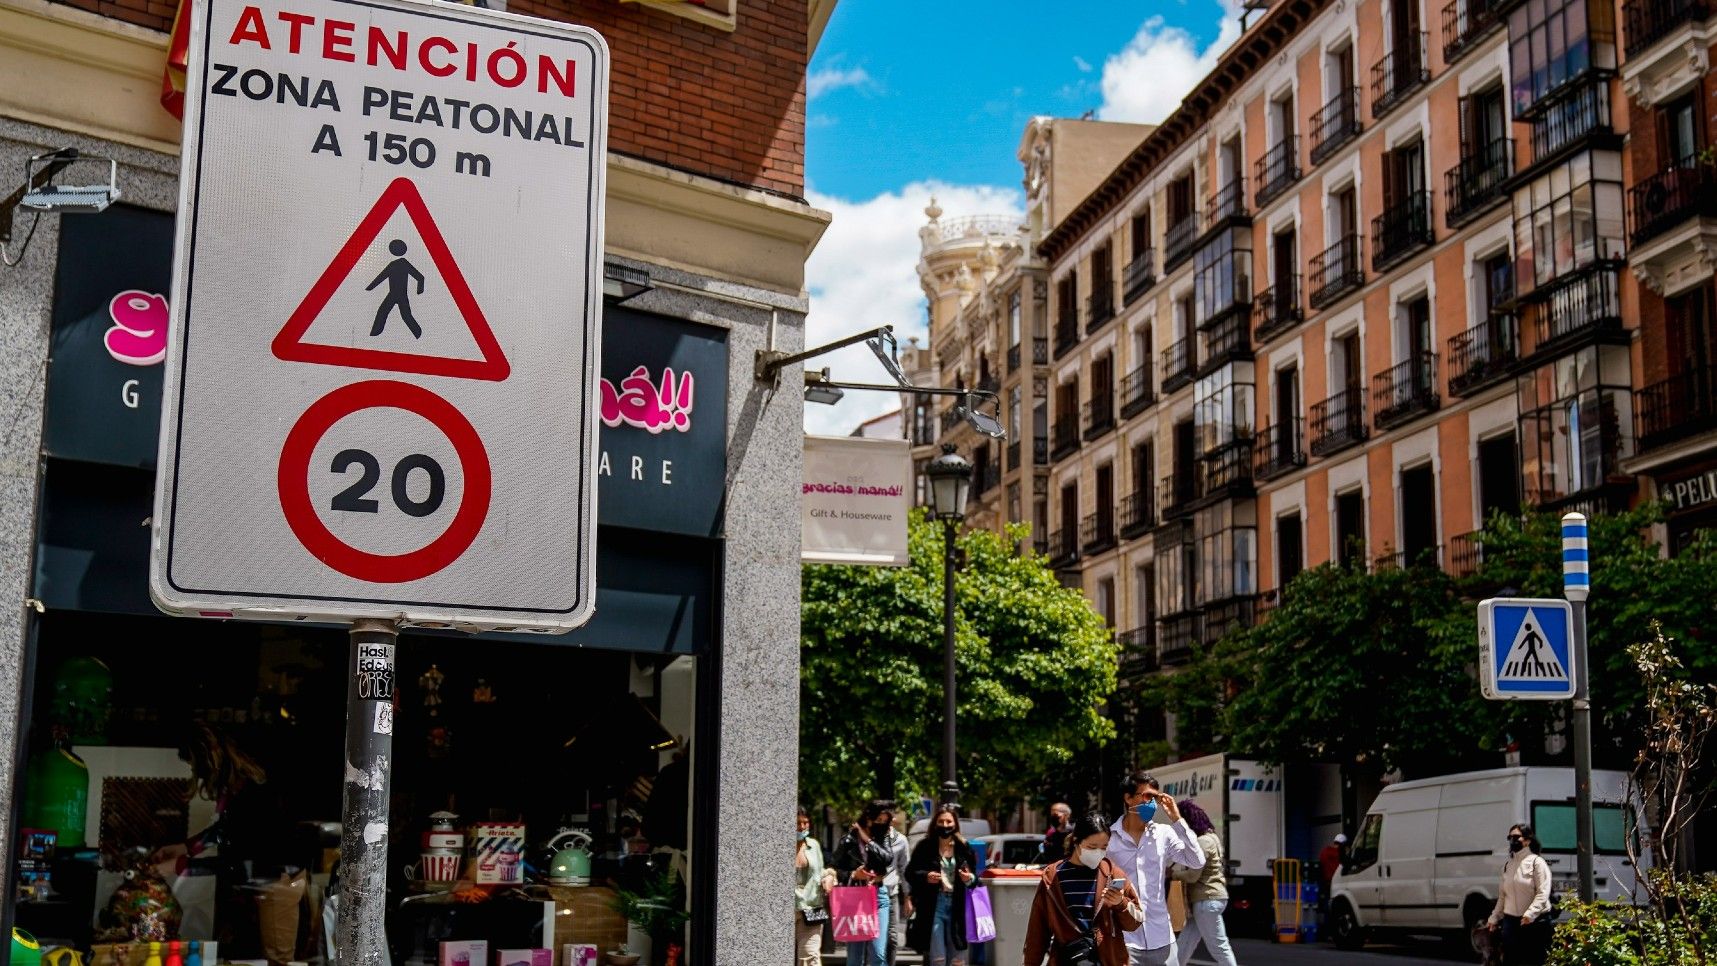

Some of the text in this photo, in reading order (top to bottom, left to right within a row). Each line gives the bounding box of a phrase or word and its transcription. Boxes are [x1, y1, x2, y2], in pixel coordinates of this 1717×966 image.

[229, 6, 577, 98] ATENCIÓN
[211, 63, 585, 148] ZONA PEATONAL
[311, 124, 491, 177] A 150 m
[330, 448, 446, 518] 20
[810, 508, 893, 521] Gift & Houseware
